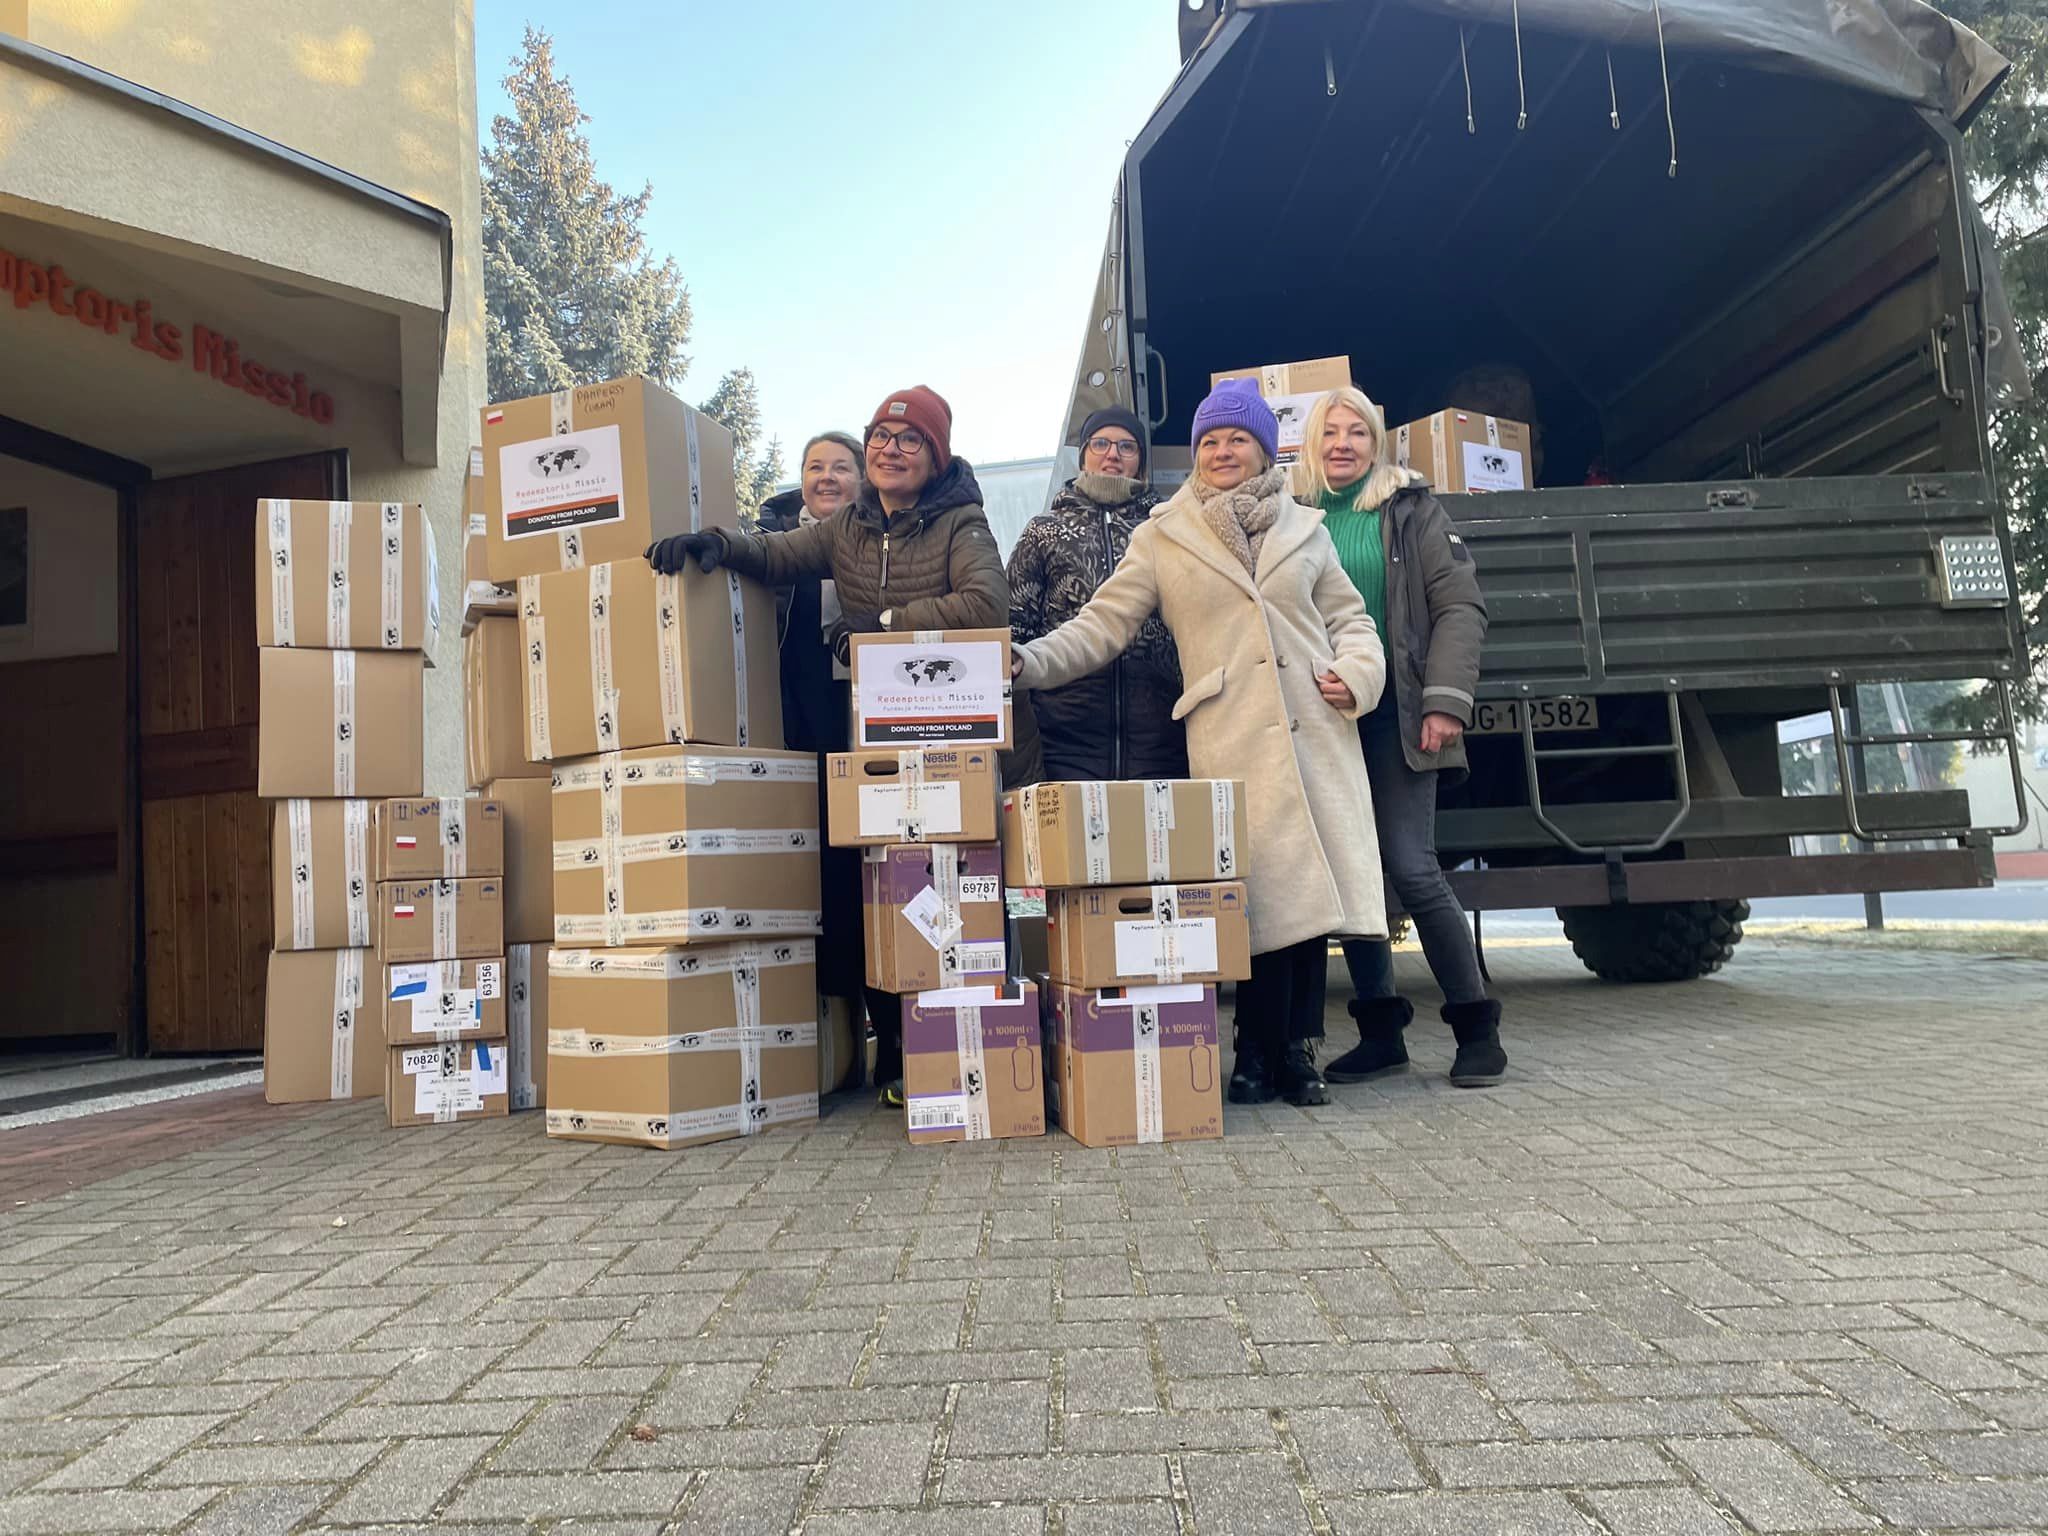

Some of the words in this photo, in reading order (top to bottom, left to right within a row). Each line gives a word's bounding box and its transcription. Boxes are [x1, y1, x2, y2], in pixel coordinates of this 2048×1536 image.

[193, 322, 334, 424] Missio
[575, 477, 606, 489] Missio
[527, 514, 556, 525] DONATION
[556, 510, 573, 520] FROM
[573, 506, 597, 517] POLAND
[877, 694, 943, 704] Redemptoris
[948, 693, 985, 702] Missio
[890, 725, 925, 733] DONATION
[926, 724, 945, 732] FROM
[945, 723, 973, 731] POLAND
[962, 883, 997, 894] 69787
[482, 964, 493, 996] 63156
[995, 1025, 1025, 1036] 1000ml
[1172, 1021, 1203, 1034] 1000ml
[406, 1053, 440, 1066] 70820
